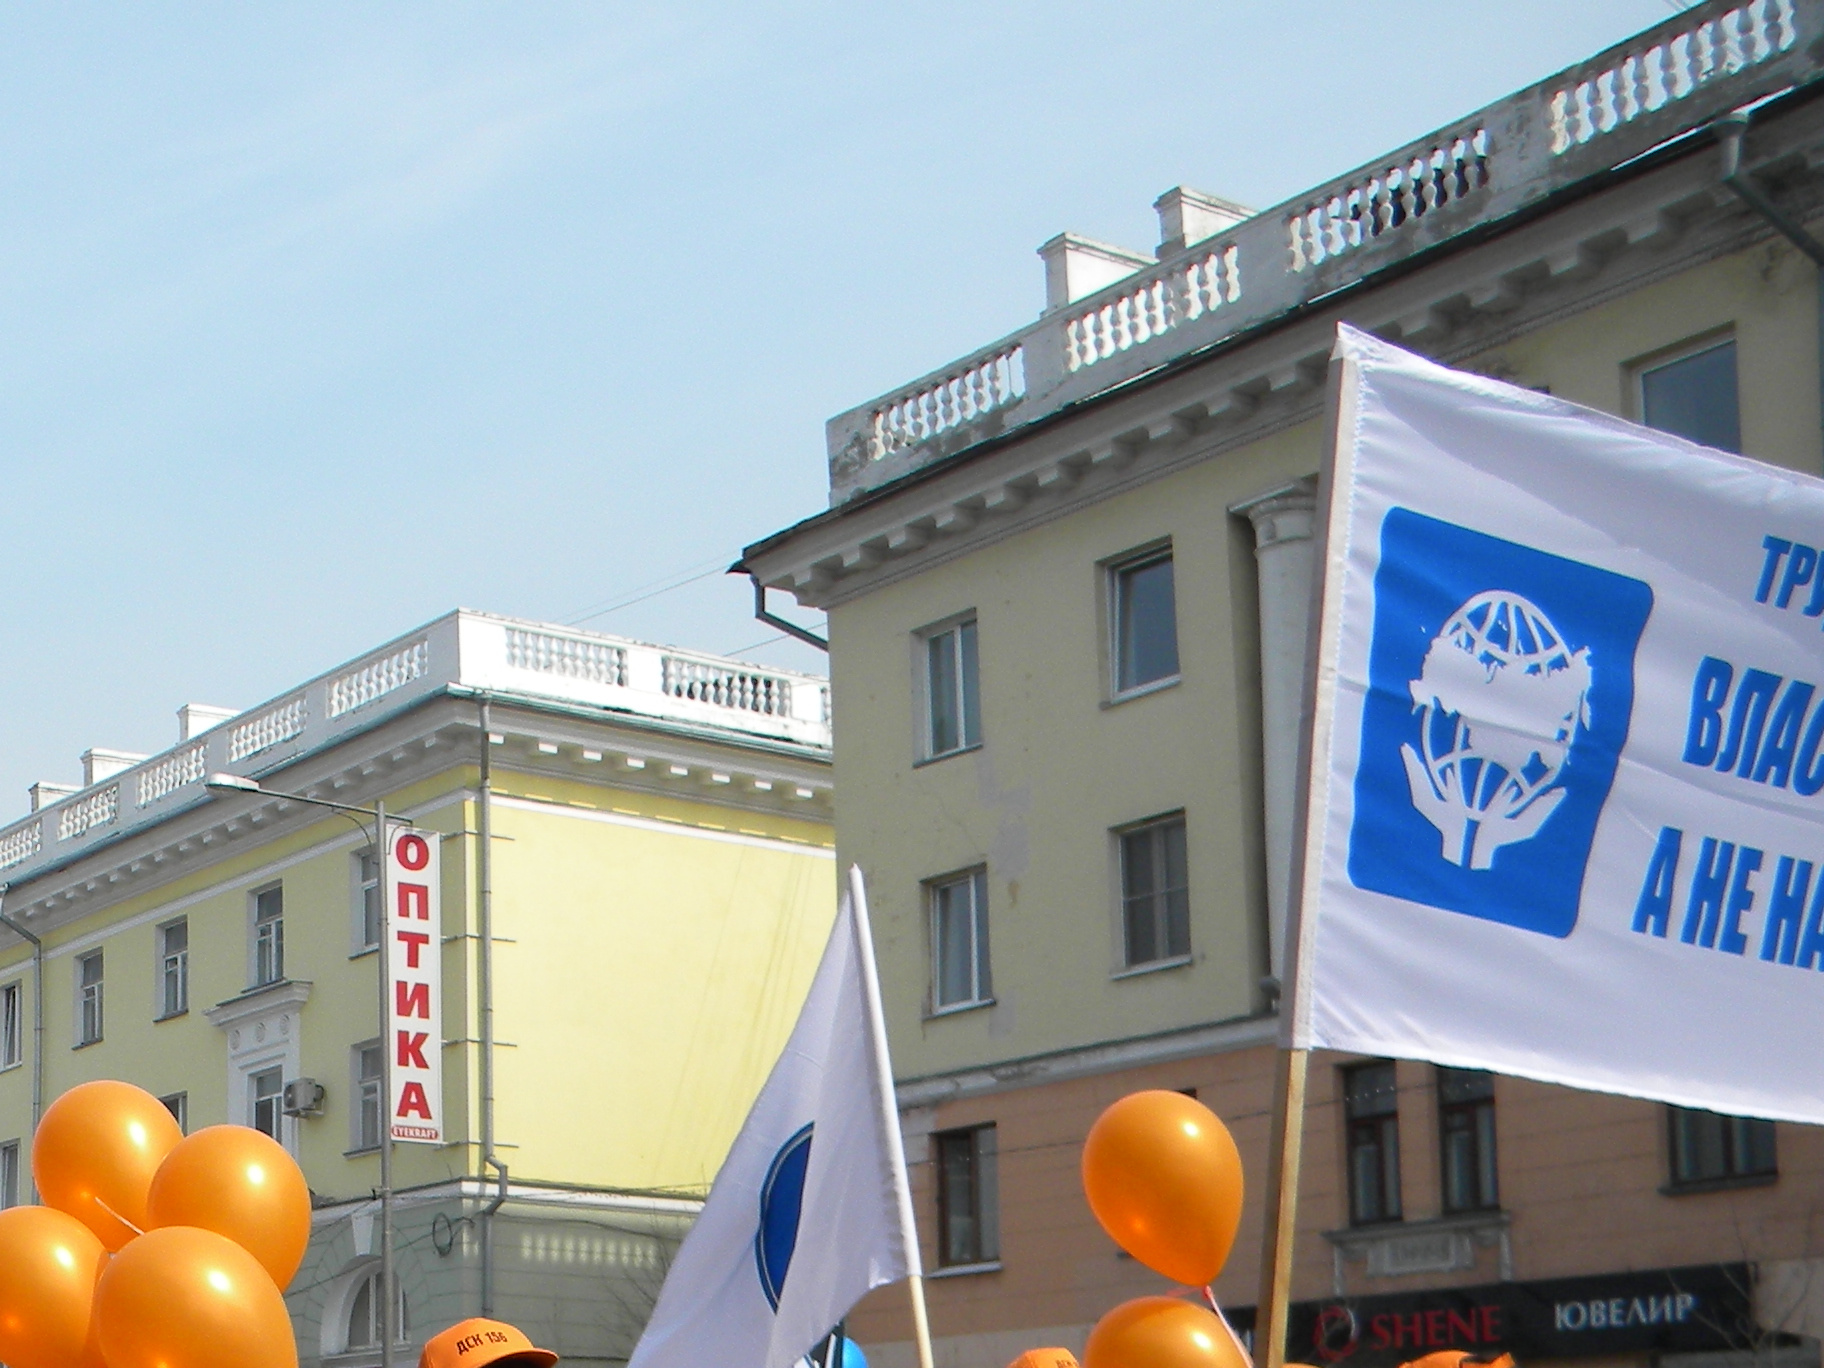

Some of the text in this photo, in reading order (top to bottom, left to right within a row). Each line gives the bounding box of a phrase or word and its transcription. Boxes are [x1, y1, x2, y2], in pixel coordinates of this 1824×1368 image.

[1753, 534, 1824, 631] ТРУ
[1630, 825, 1824, 973] А НЕ НА
[395, 833, 432, 1120] ОПТИКА
[393, 1126, 437, 1139] EYEKRAFT
[1369, 1305, 1502, 1350] SHENE
[1553, 1292, 1695, 1330] ЮВЕЛИР
[456, 1331, 508, 1356] ДСК 156
